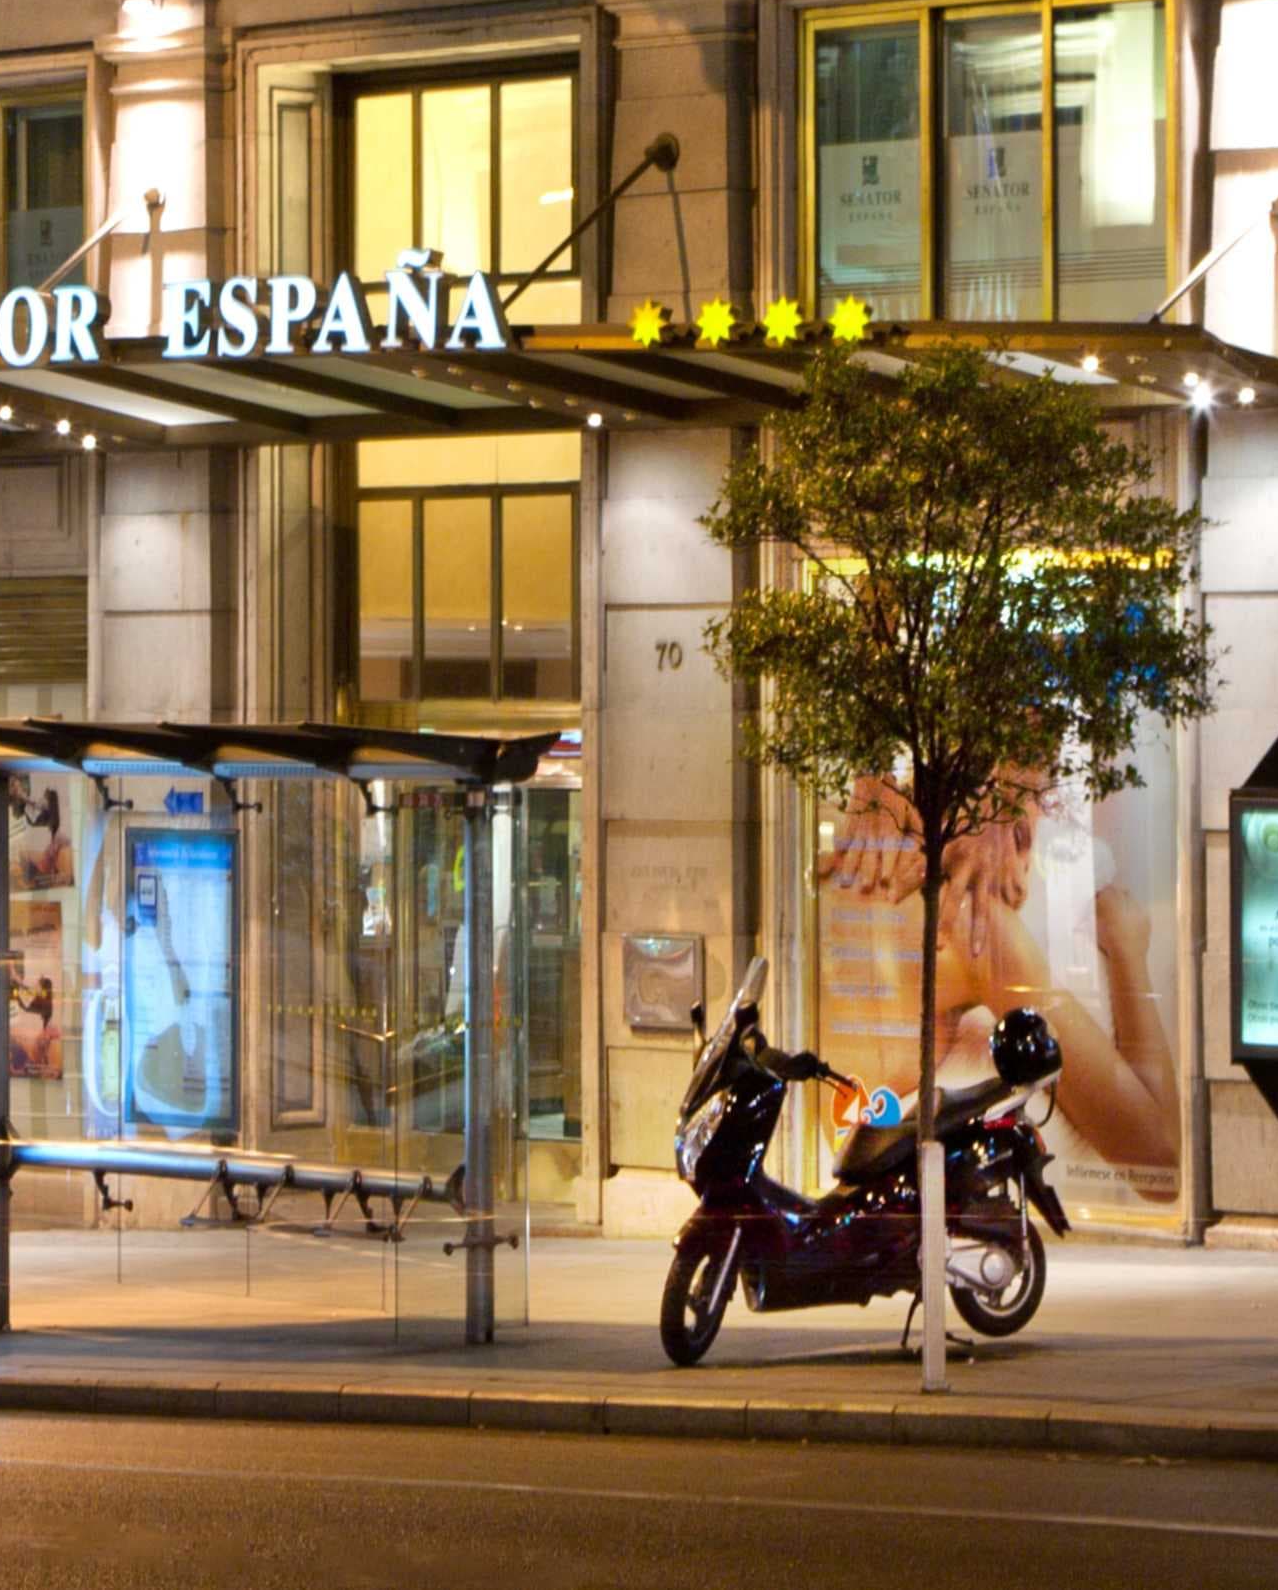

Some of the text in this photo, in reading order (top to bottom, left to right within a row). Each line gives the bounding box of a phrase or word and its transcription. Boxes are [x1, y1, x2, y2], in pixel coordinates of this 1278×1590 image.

[839, 189, 902, 206] SENATOR
[965, 181, 1031, 201] SENATOR
[160, 248, 507, 360] ESPAÑA
[654, 639, 683, 672] 70
